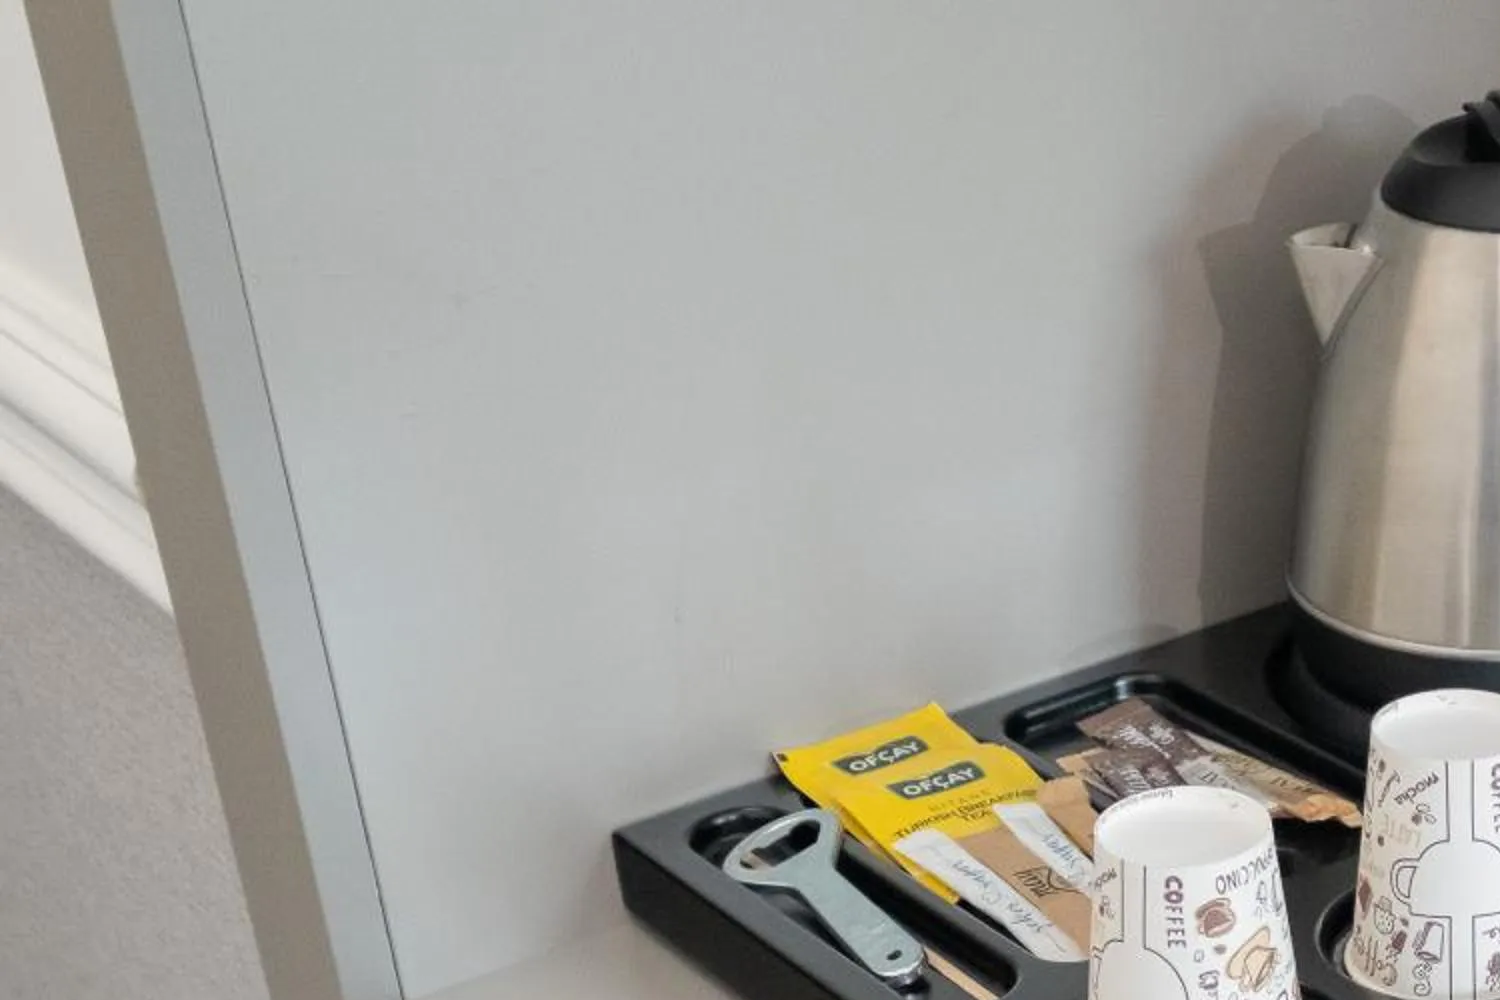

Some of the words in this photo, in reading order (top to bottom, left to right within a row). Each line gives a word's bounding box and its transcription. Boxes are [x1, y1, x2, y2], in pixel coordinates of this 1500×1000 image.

[850, 740, 921, 772] OFÇAY
[902, 766, 977, 796] OFÇAY
[1163, 873, 1187, 950] COFFEE
